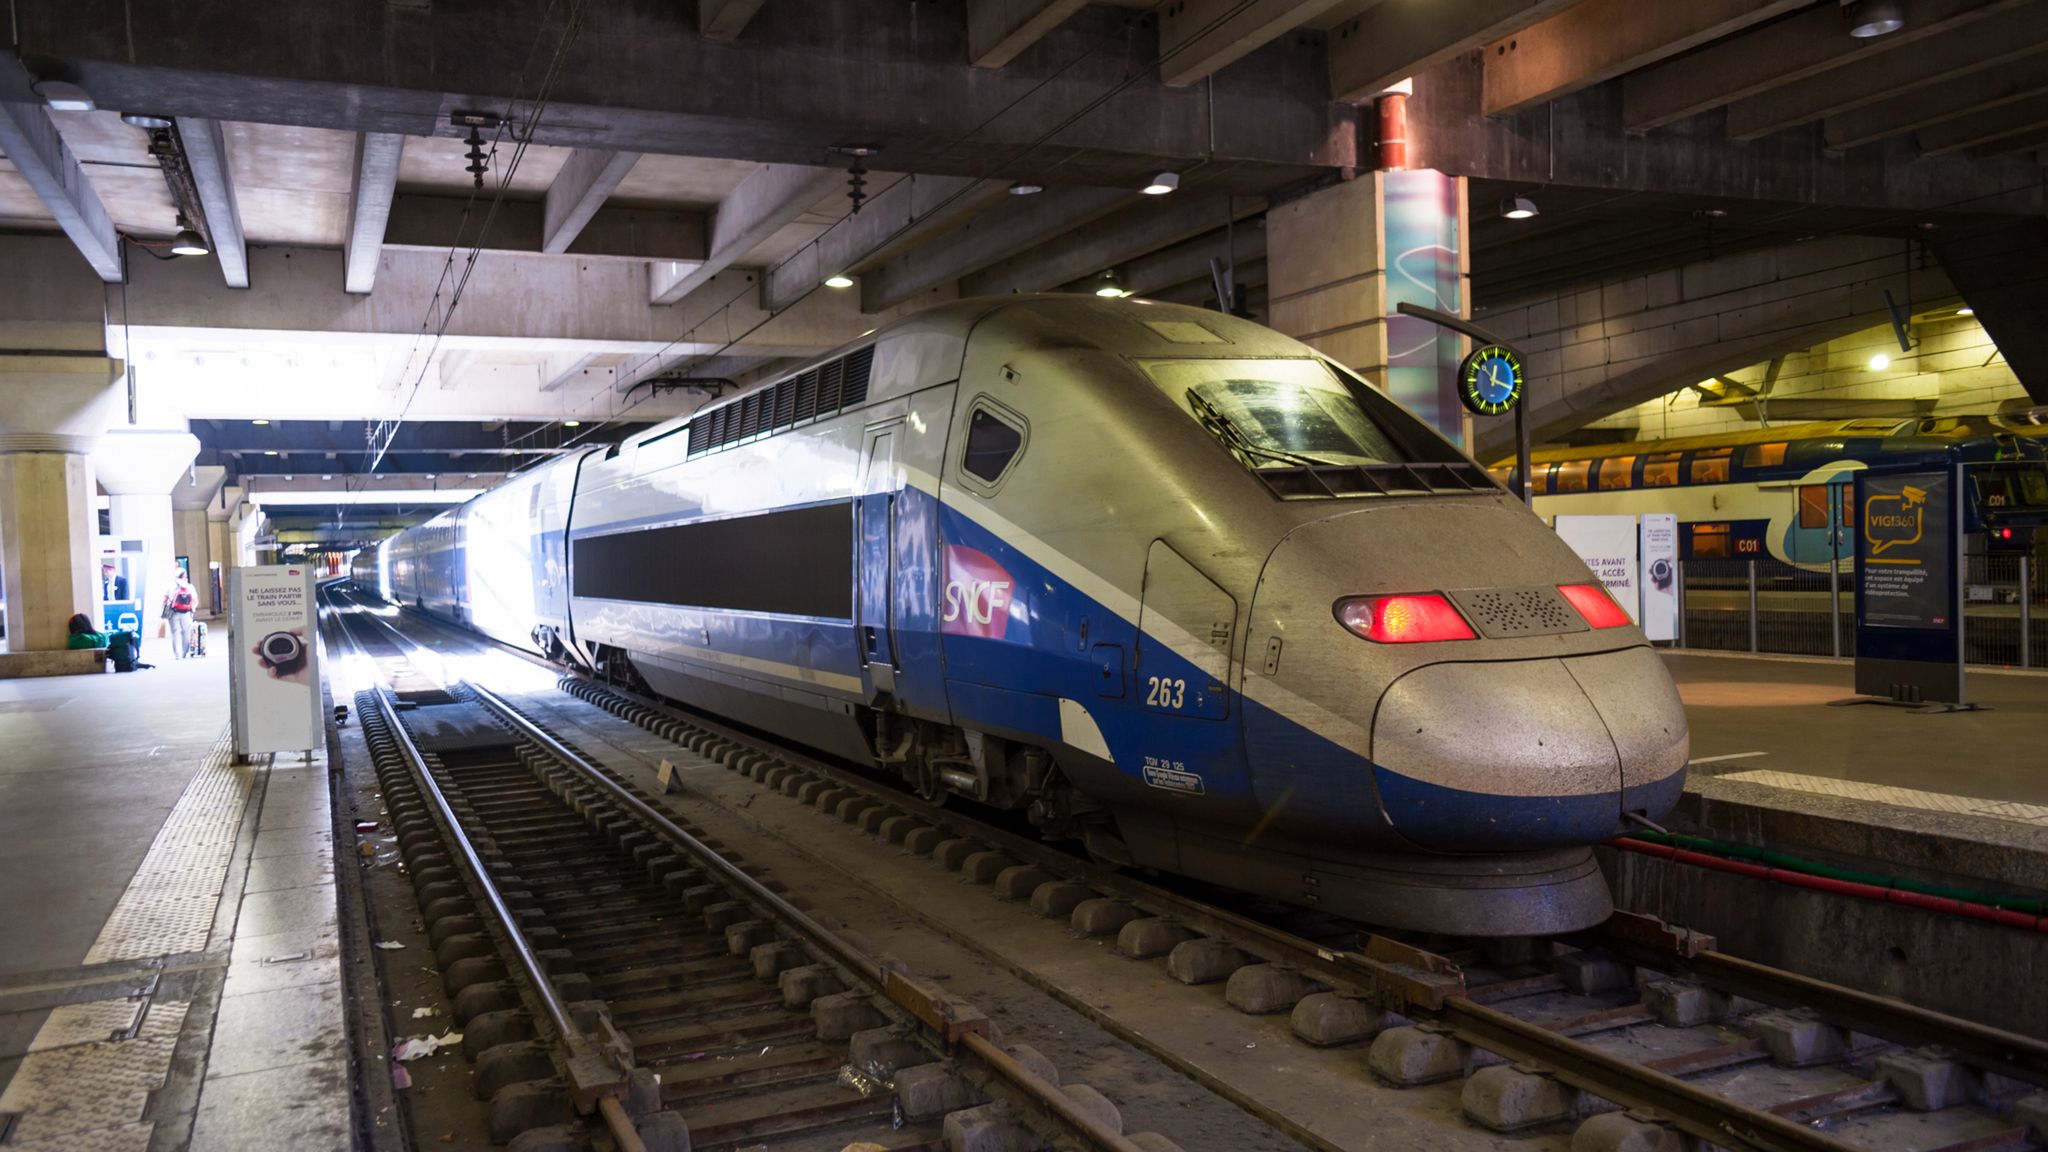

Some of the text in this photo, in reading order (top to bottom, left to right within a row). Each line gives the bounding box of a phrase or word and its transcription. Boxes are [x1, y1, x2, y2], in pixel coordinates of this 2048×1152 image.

[1989, 495, 2005, 506] C01
[1739, 539, 1757, 552] C01
[1601, 558, 1626, 566] AVANT
[1602, 568, 1625, 577] ACCÈS
[943, 580, 1010, 624] SNCF
[1146, 676, 1186, 709] 263
